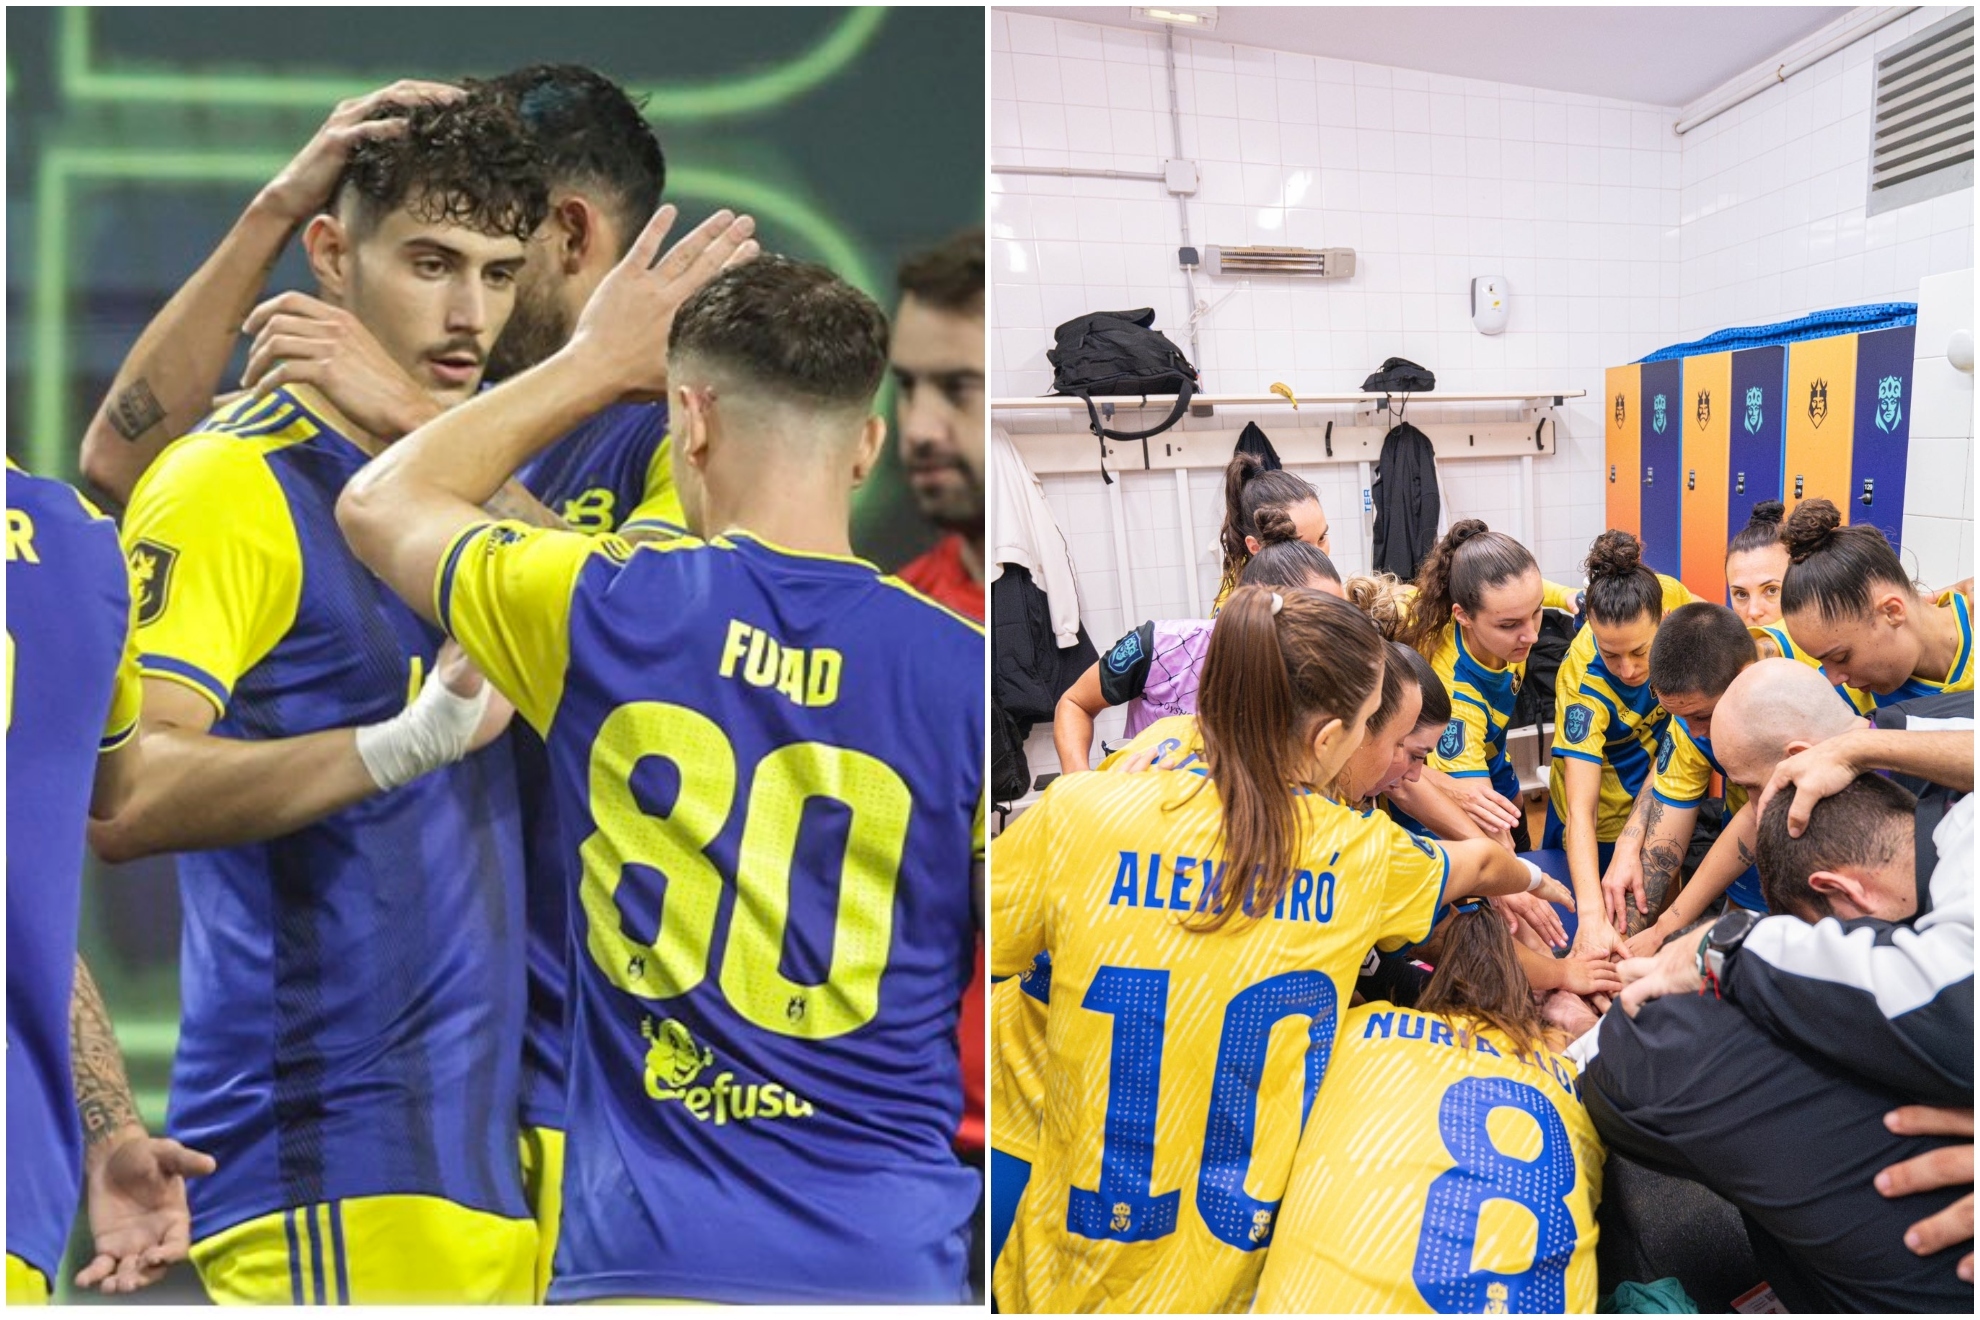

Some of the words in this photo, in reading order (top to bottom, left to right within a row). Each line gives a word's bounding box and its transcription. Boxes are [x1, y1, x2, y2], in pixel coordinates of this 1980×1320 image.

[1363, 489, 1372, 513] TER
[718, 618, 843, 708] FUAD
[1163, 701, 1194, 716] OYSH
[578, 700, 913, 1040] 80
[1108, 850, 1226, 915] ALEX
[1363, 1011, 1502, 1058] NURIA
[1066, 965, 1338, 1253] 10
[1411, 1075, 1578, 1314] 8
